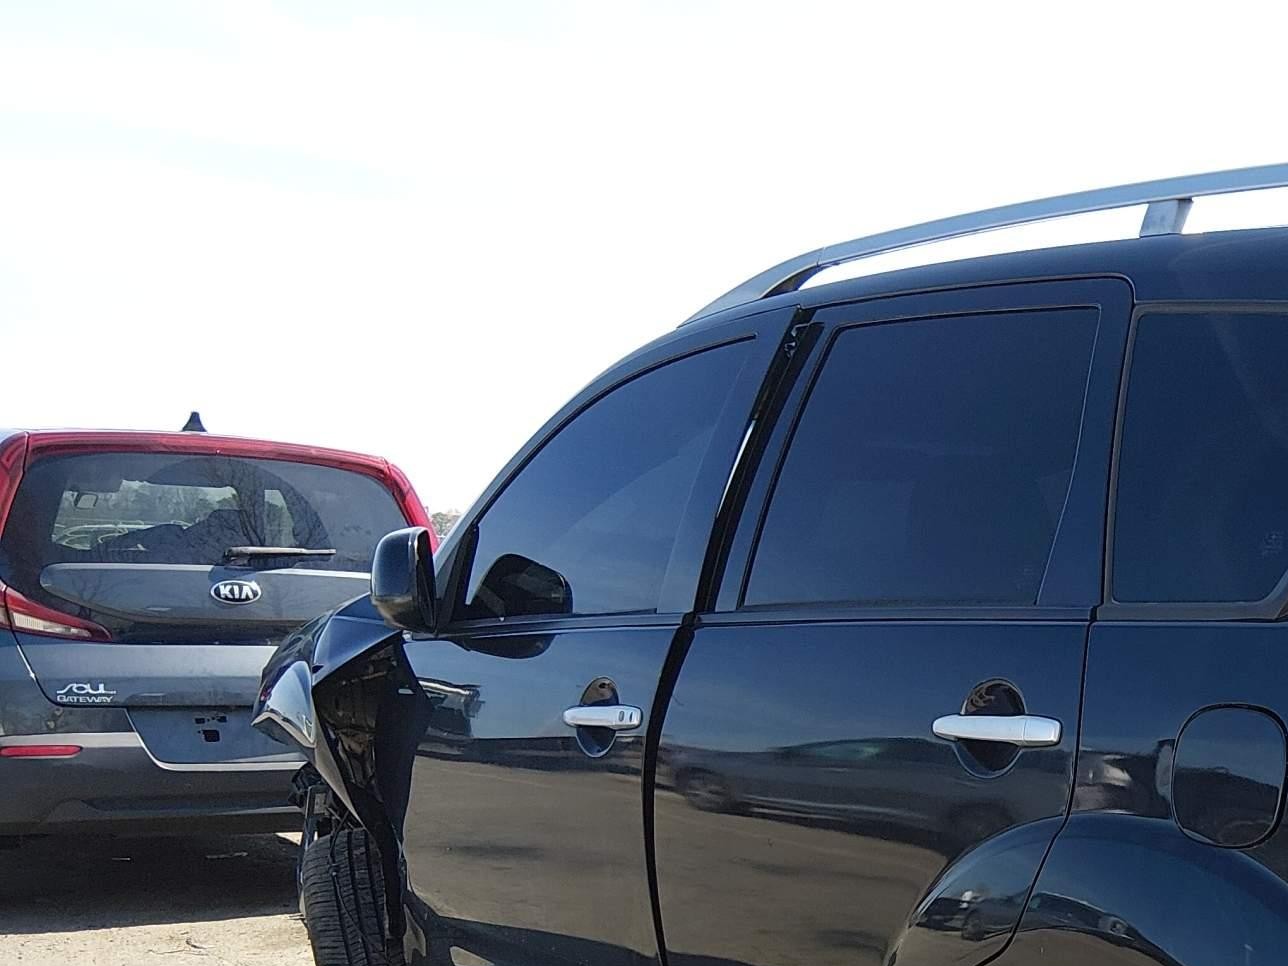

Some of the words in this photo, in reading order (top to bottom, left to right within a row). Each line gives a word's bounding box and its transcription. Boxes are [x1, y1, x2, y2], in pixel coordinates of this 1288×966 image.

[219, 584, 254, 600] KIA
[56, 683, 117, 694] SOUL
[56, 694, 114, 703] GATEWAY
